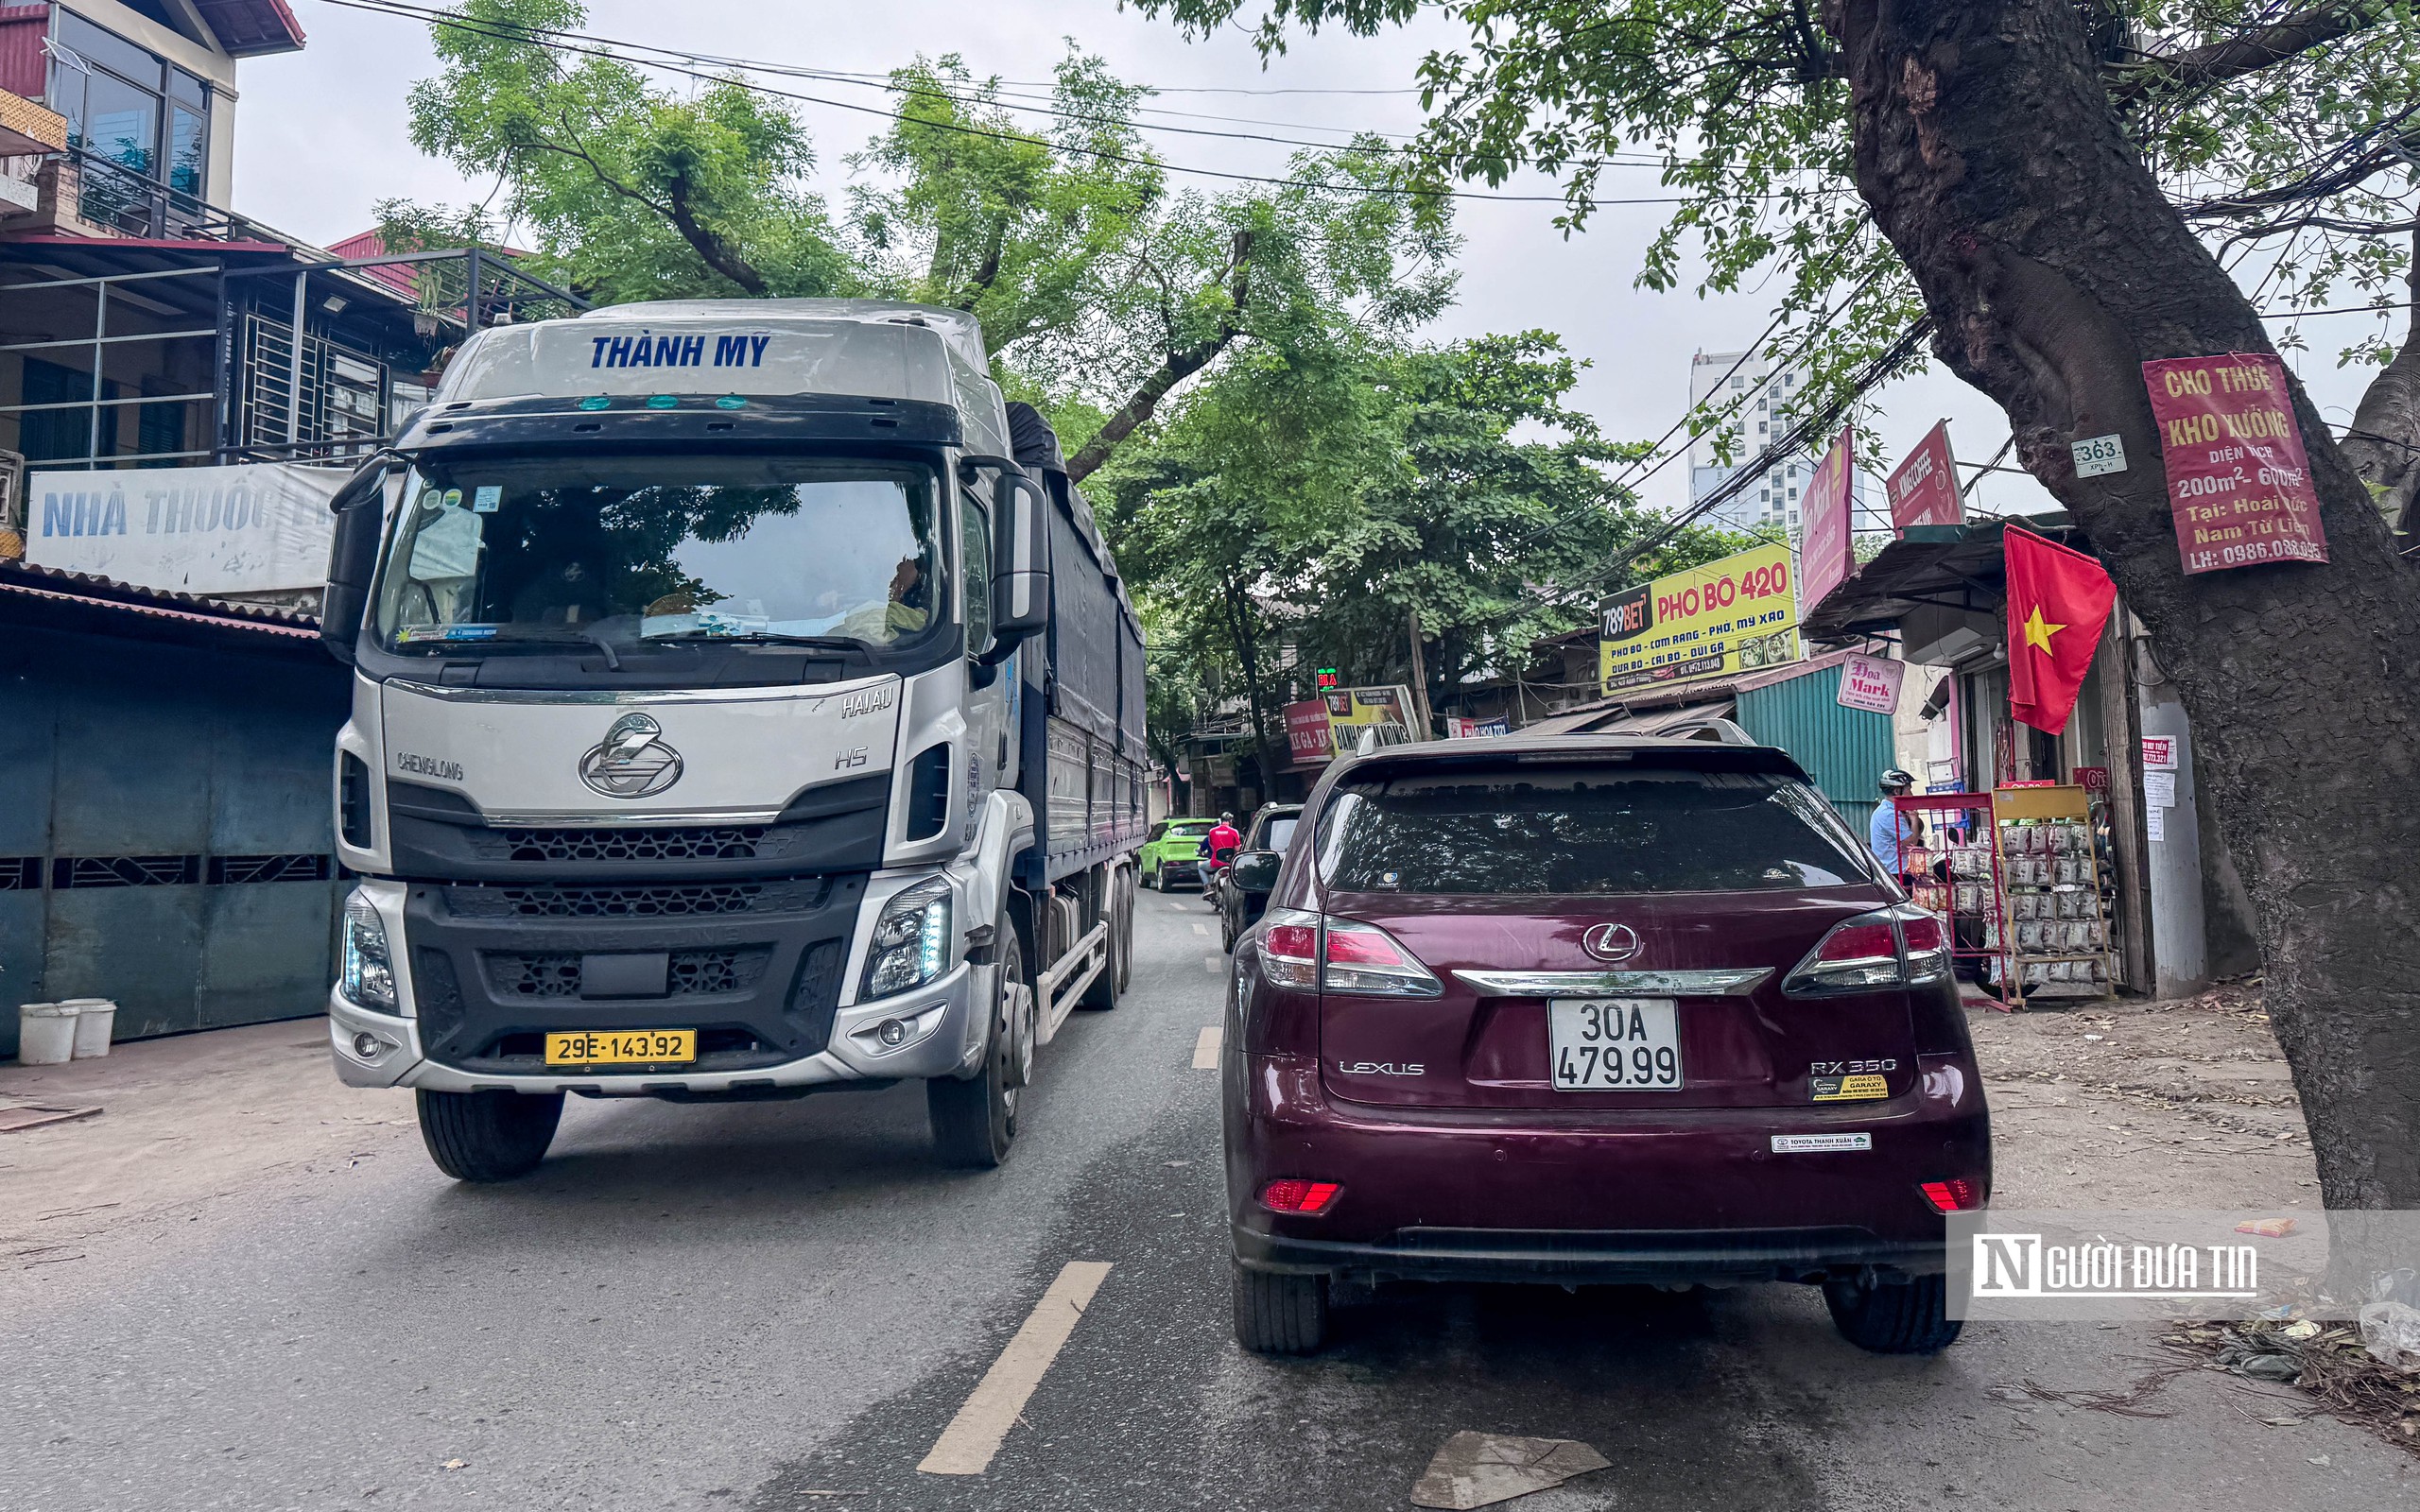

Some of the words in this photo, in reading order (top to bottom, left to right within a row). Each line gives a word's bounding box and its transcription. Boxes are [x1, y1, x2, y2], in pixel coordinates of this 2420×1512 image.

[591, 330, 705, 368] THÀNH
[2164, 369, 2213, 398] CHO
[2167, 413, 2220, 447] KHO
[2082, 441, 2117, 461] 363
[2208, 446, 2244, 463] DIỆN
[43, 480, 127, 538] NHÀ
[2233, 494, 2280, 513] Hoài
[2194, 525, 2242, 544] Nam
[2189, 550, 2219, 569] LH:
[1740, 561, 1787, 601] 420
[1602, 597, 1645, 637] 789BET
[1672, 630, 1700, 644] RANG
[1849, 679, 1890, 697] Mark
[397, 751, 463, 782] CHENGLONG
[1580, 1003, 1648, 1041] 30A
[558, 1036, 683, 1059] 29E-143.92
[1340, 1060, 1426, 1076] LEXUS
[1558, 1046, 1676, 1085] 479.99
[1810, 1061, 1846, 1075] RX
[1848, 1058, 1897, 1073] 350
